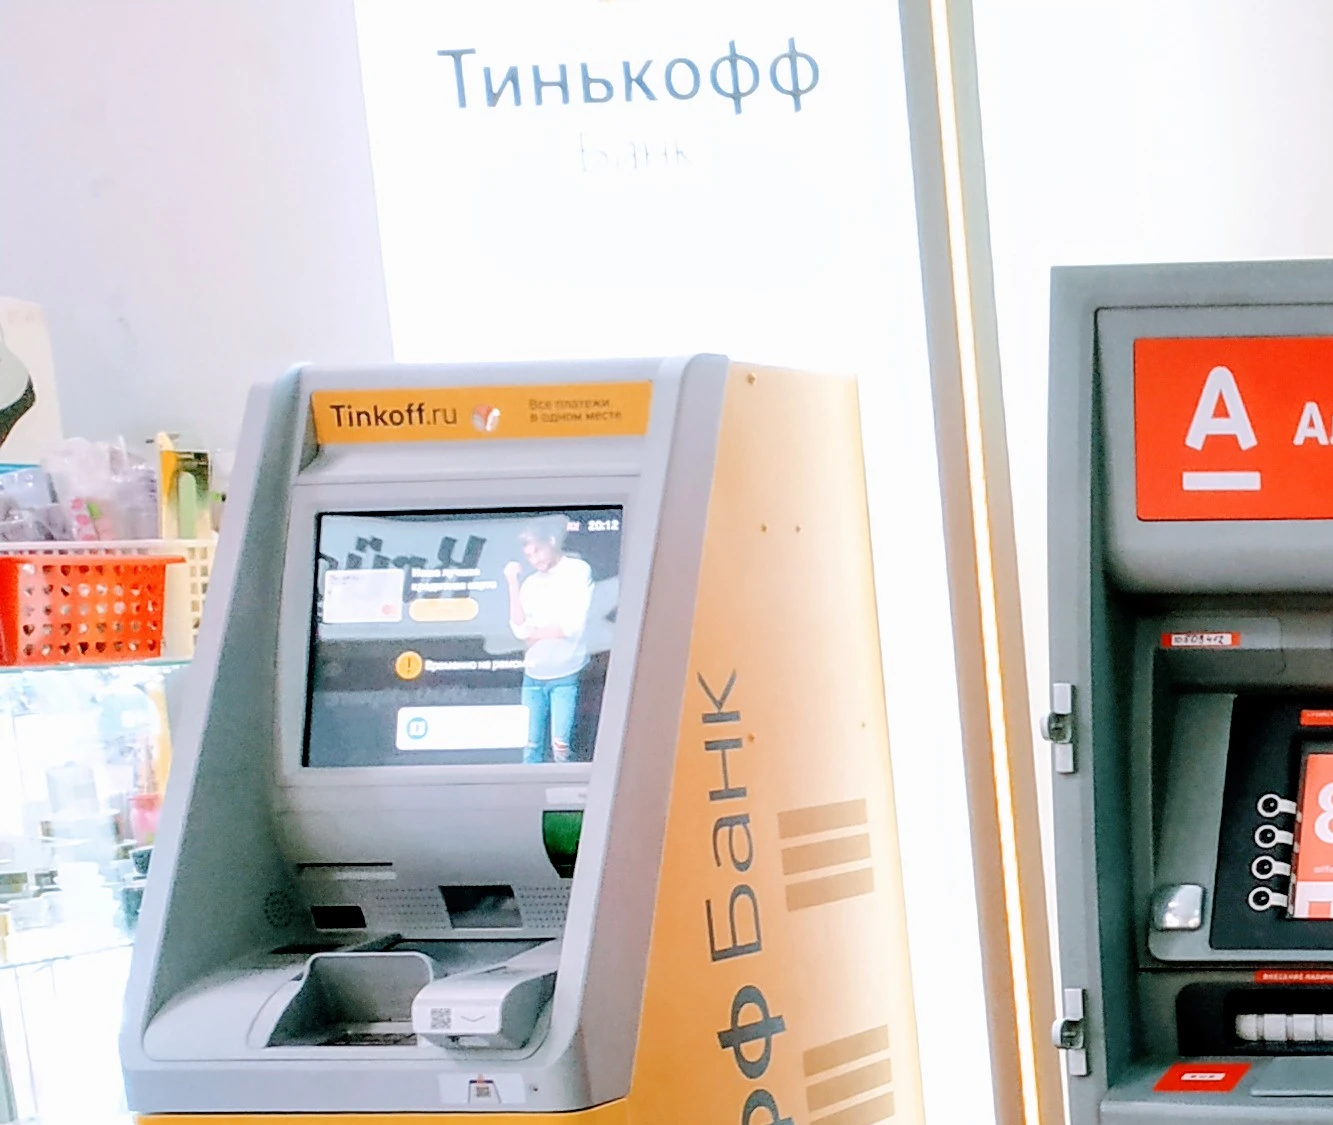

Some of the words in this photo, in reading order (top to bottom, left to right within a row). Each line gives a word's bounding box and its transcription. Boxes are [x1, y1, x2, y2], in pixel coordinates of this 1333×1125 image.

[437, 37, 819, 115] Тинькофф
[329, 402, 458, 428] Tinkoff.ru
[697, 669, 762, 963] Банк
